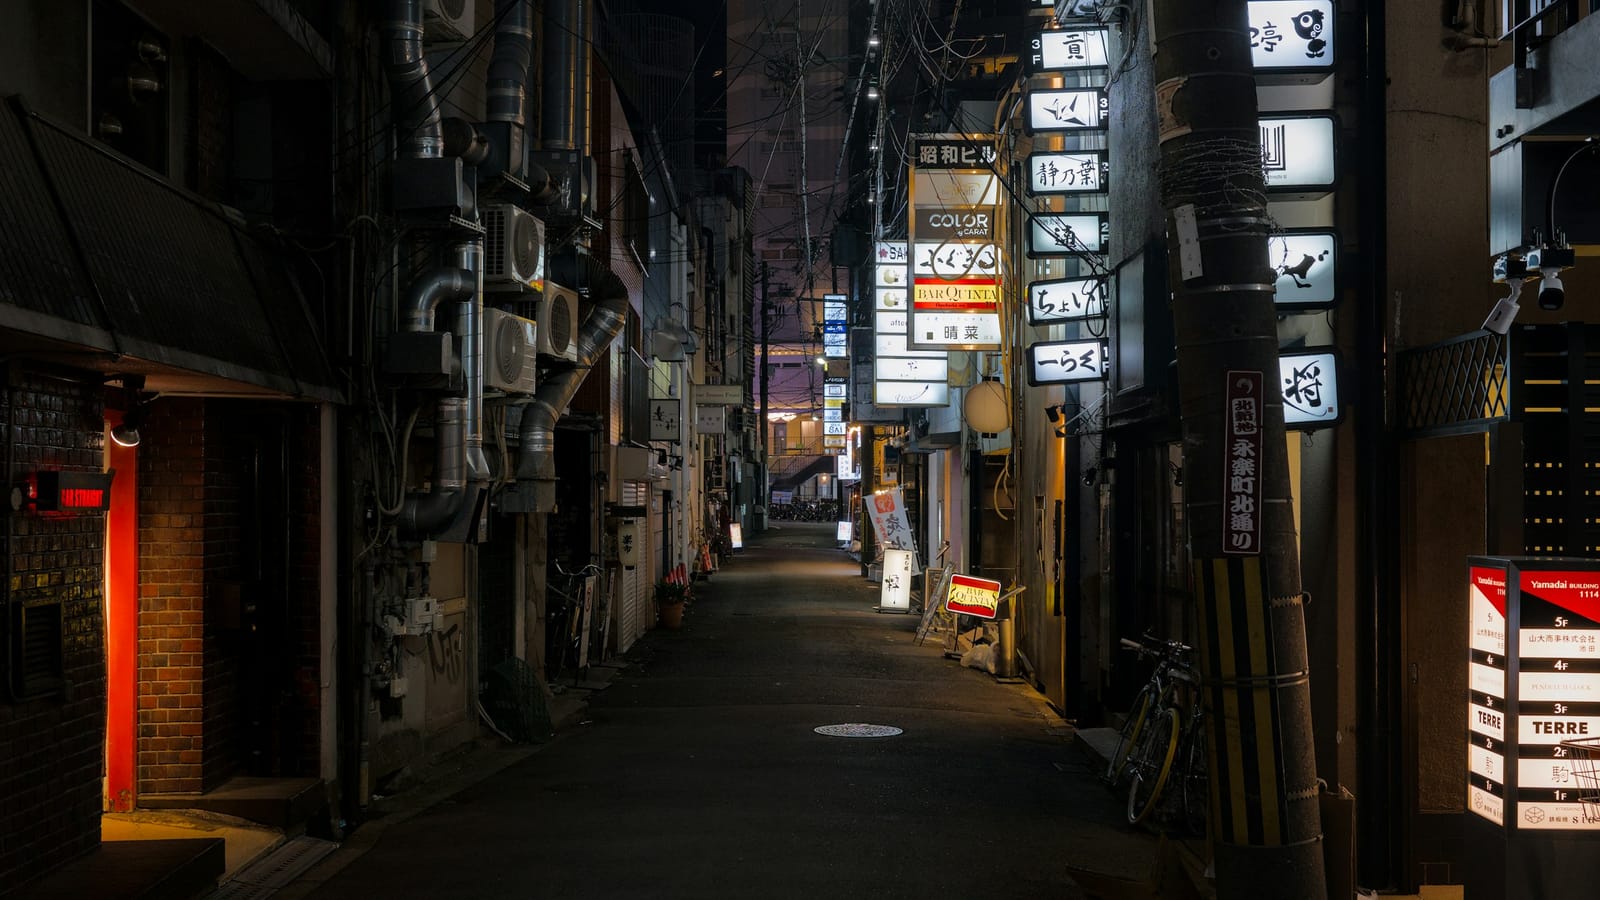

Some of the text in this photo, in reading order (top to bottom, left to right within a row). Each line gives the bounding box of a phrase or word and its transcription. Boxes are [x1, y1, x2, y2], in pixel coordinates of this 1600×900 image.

[920, 145, 997, 164] 昭和ビル
[1036, 159, 1096, 187] 静乃葉
[929, 214, 988, 228] COLOR
[918, 288, 943, 300] BAR
[944, 325, 978, 340] 晴菜
[1038, 349, 1096, 372] 一らく
[1530, 580, 1567, 590] Yamadai
[1580, 591, 1600, 599] 1114
[1554, 616, 1569, 628] 5F
[1554, 659, 1569, 671] 4F
[1553, 703, 1568, 715] 3F
[1478, 710, 1502, 730] TERRE
[1532, 721, 1589, 735] TERRE
[1553, 746, 1568, 758] 2F
[1553, 790, 1568, 801] 1F
